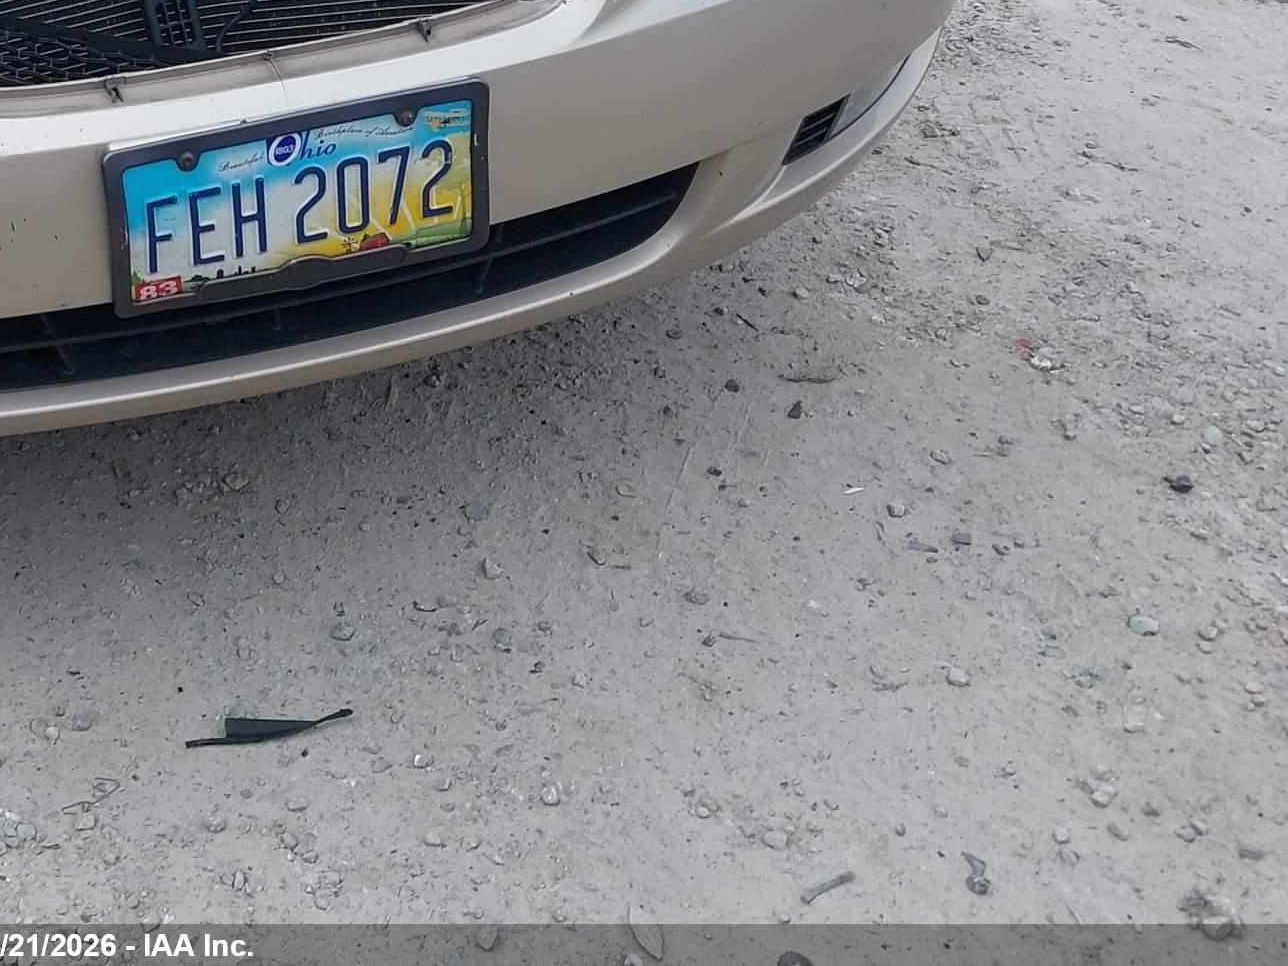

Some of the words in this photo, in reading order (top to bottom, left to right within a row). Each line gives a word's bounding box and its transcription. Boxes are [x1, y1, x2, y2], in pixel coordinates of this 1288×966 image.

[218, 152, 265, 172] Beautiful
[268, 130, 337, 167] Ohio
[275, 144, 295, 156] 1803
[146, 176, 268, 274] FEH
[293, 138, 454, 244] 2072
[139, 280, 178, 301] 83
